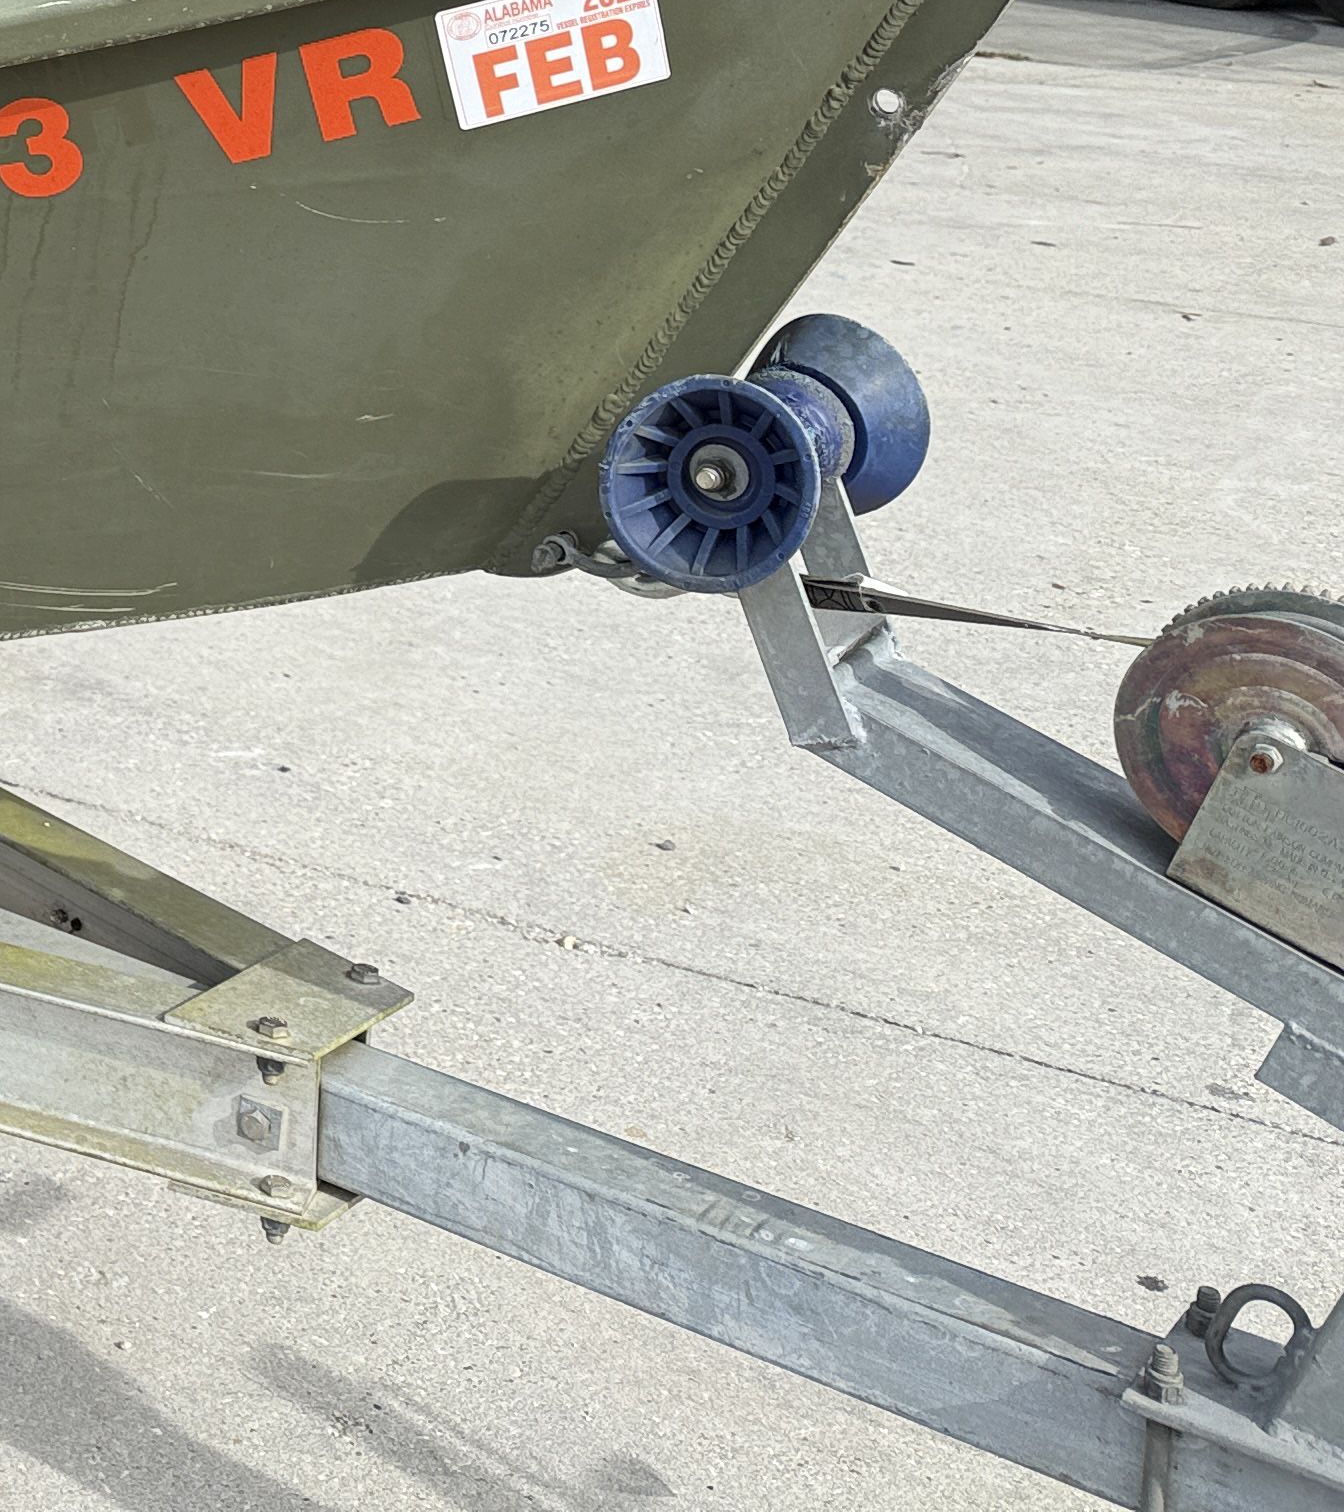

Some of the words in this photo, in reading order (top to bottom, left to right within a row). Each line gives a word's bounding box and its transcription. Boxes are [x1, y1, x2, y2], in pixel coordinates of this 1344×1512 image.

[472, 19, 641, 118] FEB
[488, 19, 550, 45] 072275
[175, 27, 422, 165] VR
